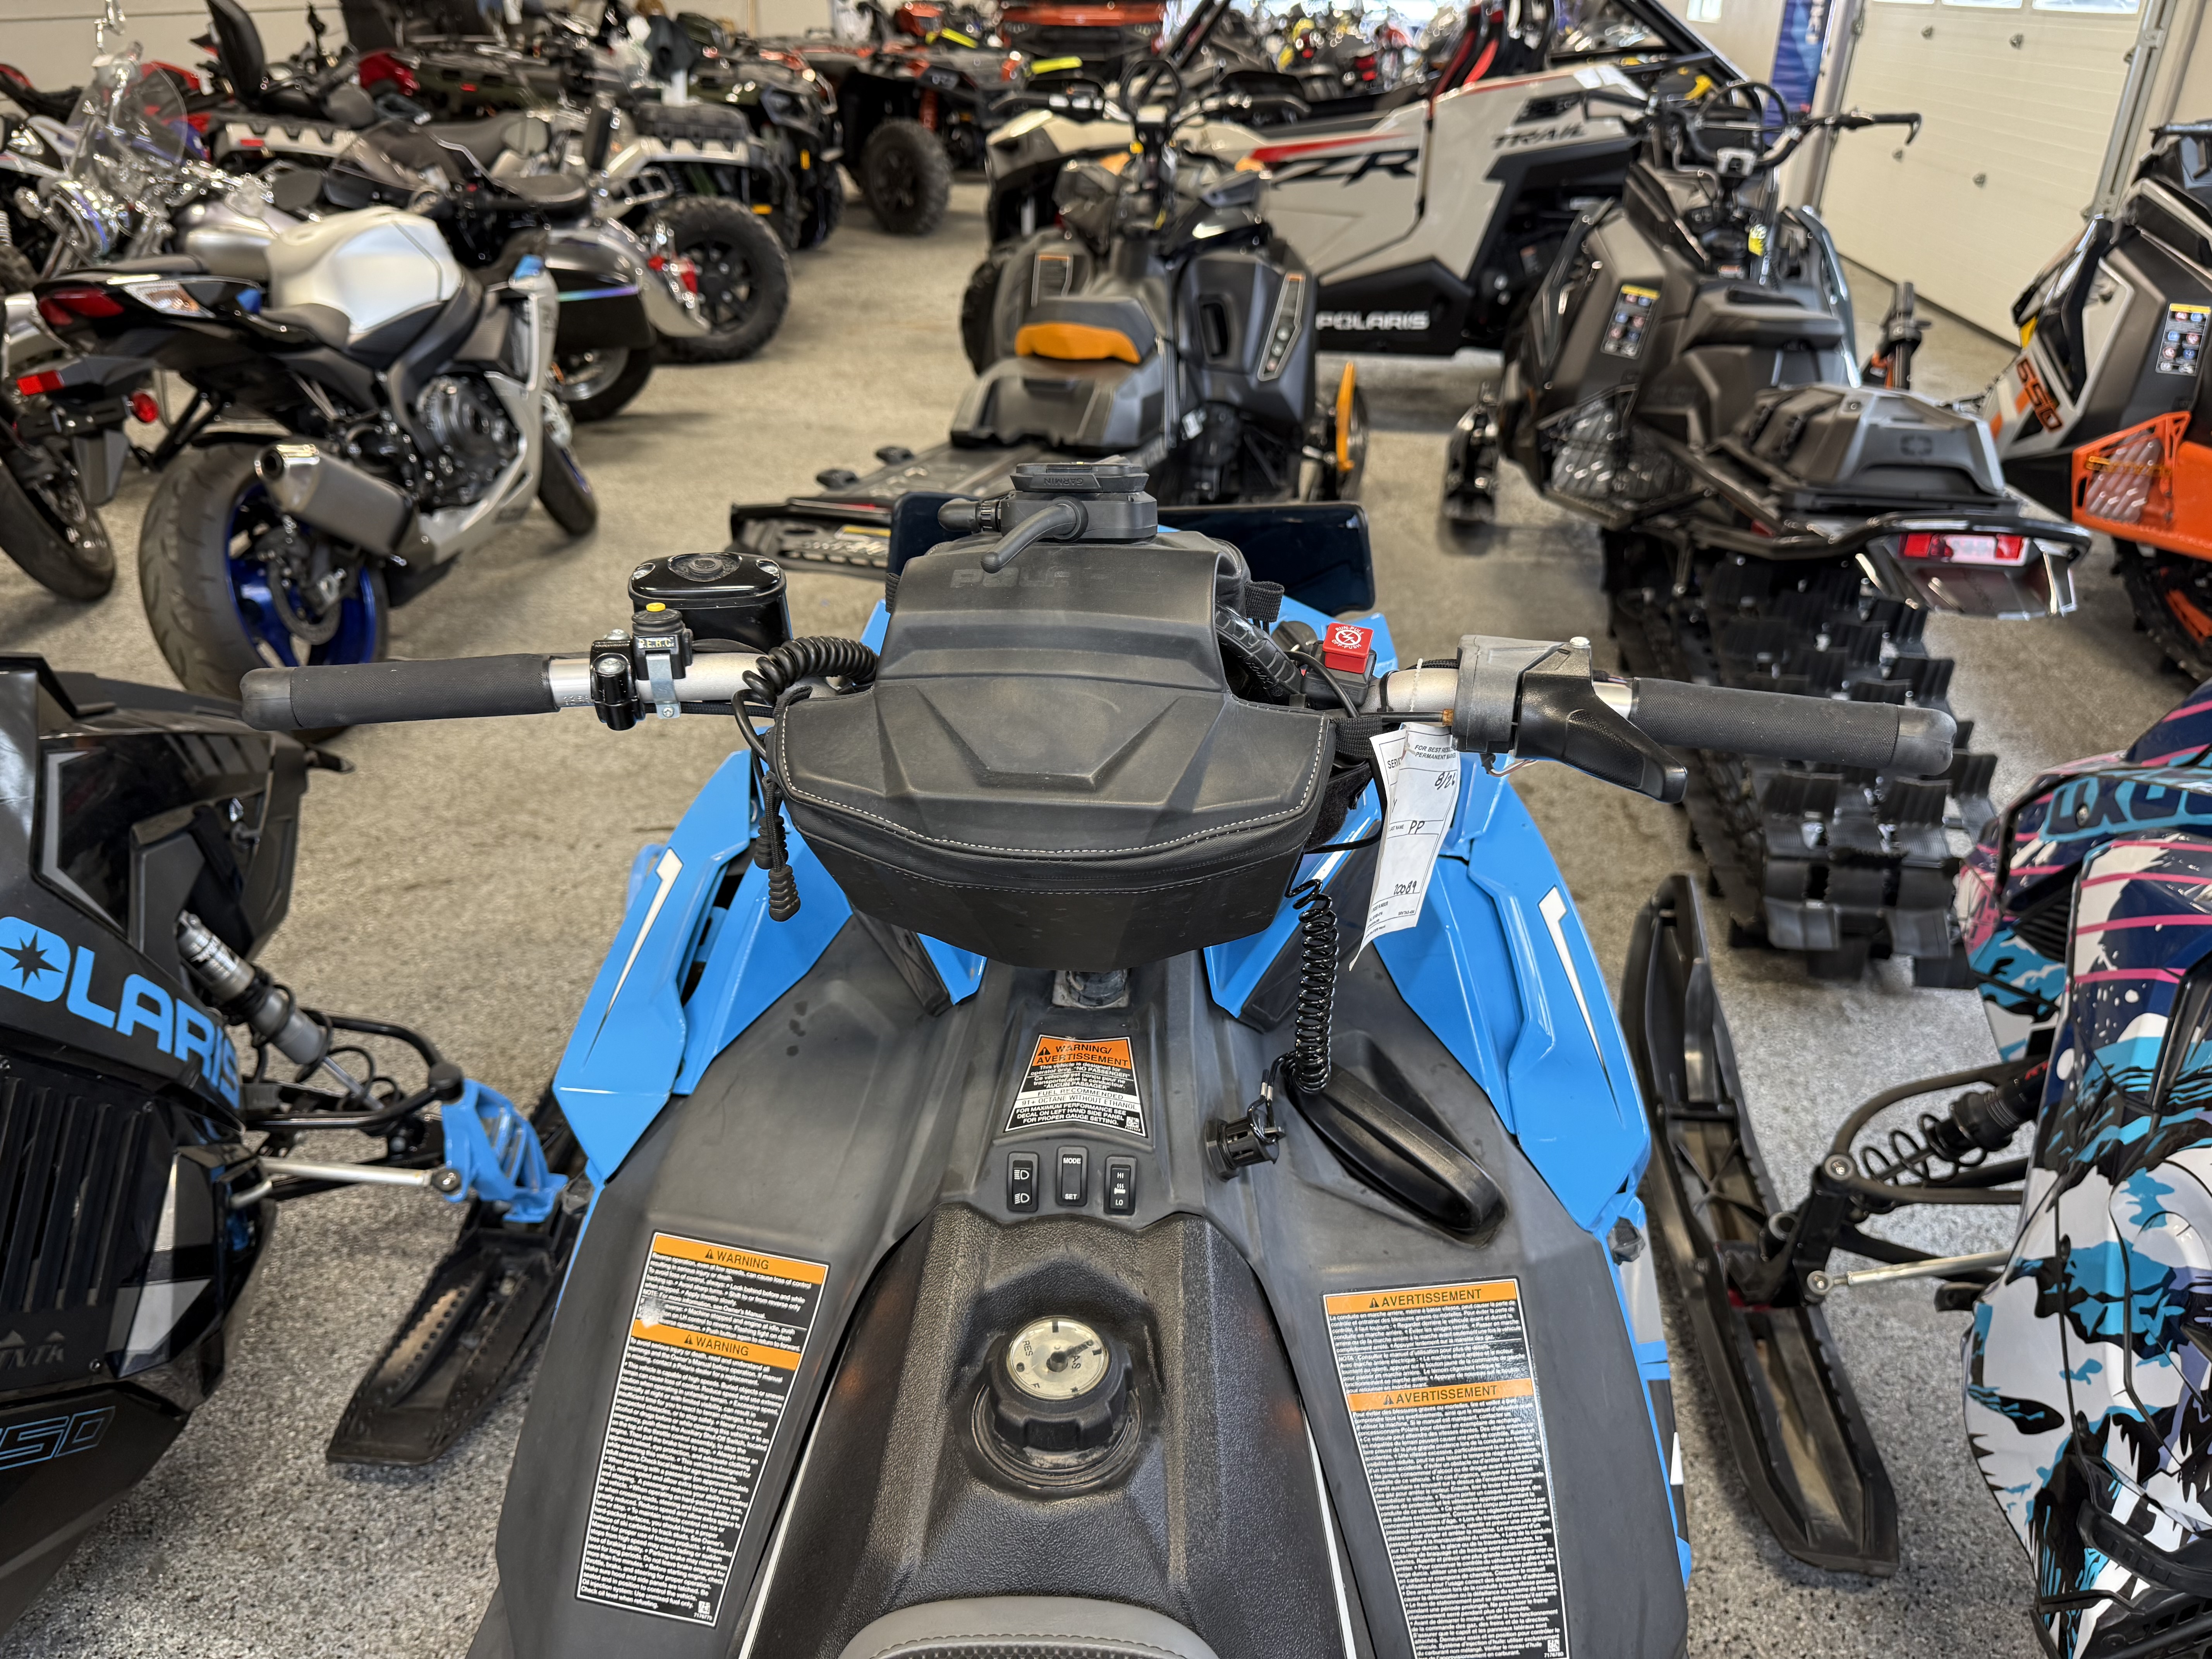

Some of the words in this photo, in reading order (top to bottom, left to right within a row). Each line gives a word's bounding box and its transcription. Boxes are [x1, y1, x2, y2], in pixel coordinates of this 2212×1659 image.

[1274, 149, 1418, 188] ZR
[1315, 311, 1429, 330] POLARIS
[1408, 821, 1425, 834] PP
[1056, 1044, 1112, 1054] WARNING/
[1037, 1053, 1128, 1066] AVERTISSEMENT
[1060, 1088, 1123, 1099] RECOMMENDED
[1063, 1103, 1112, 1113] PERFORMANCE
[1069, 1095, 1102, 1103] WITHOUT
[1104, 1099, 1137, 1110] ETHANOL
[1090, 1116, 1118, 1125] SETTING.
[1103, 1113, 1124, 1121] PANEL
[717, 1250, 769, 1270] WARNING
[1382, 1289, 1481, 1307] AVERTISSEMENT
[696, 1337, 749, 1356] WARNING
[1023, 1340, 1033, 1356] RES
[1396, 1385, 1497, 1405] AVERTISSEMENT
[0, 1406, 116, 1470] 50
